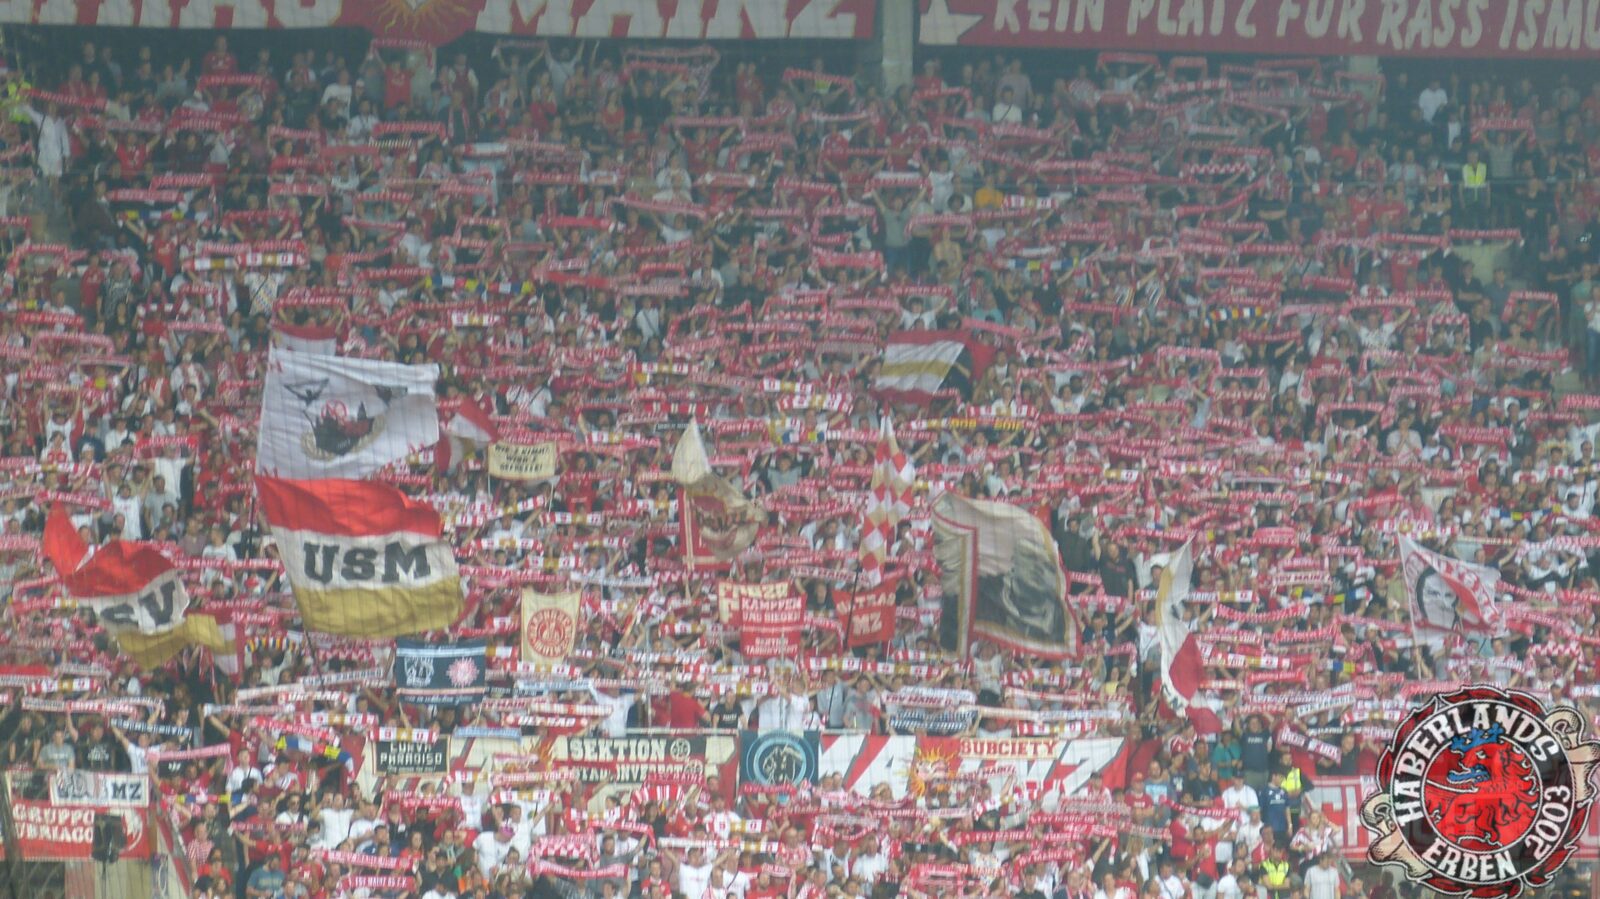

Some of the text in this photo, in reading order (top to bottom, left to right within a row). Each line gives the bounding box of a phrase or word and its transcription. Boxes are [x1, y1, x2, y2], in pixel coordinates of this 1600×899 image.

[303, 541, 431, 584] USM
[570, 738, 667, 762] SEKTION
[960, 740, 1057, 756] SUBCIETY
[111, 782, 142, 801] MZ
